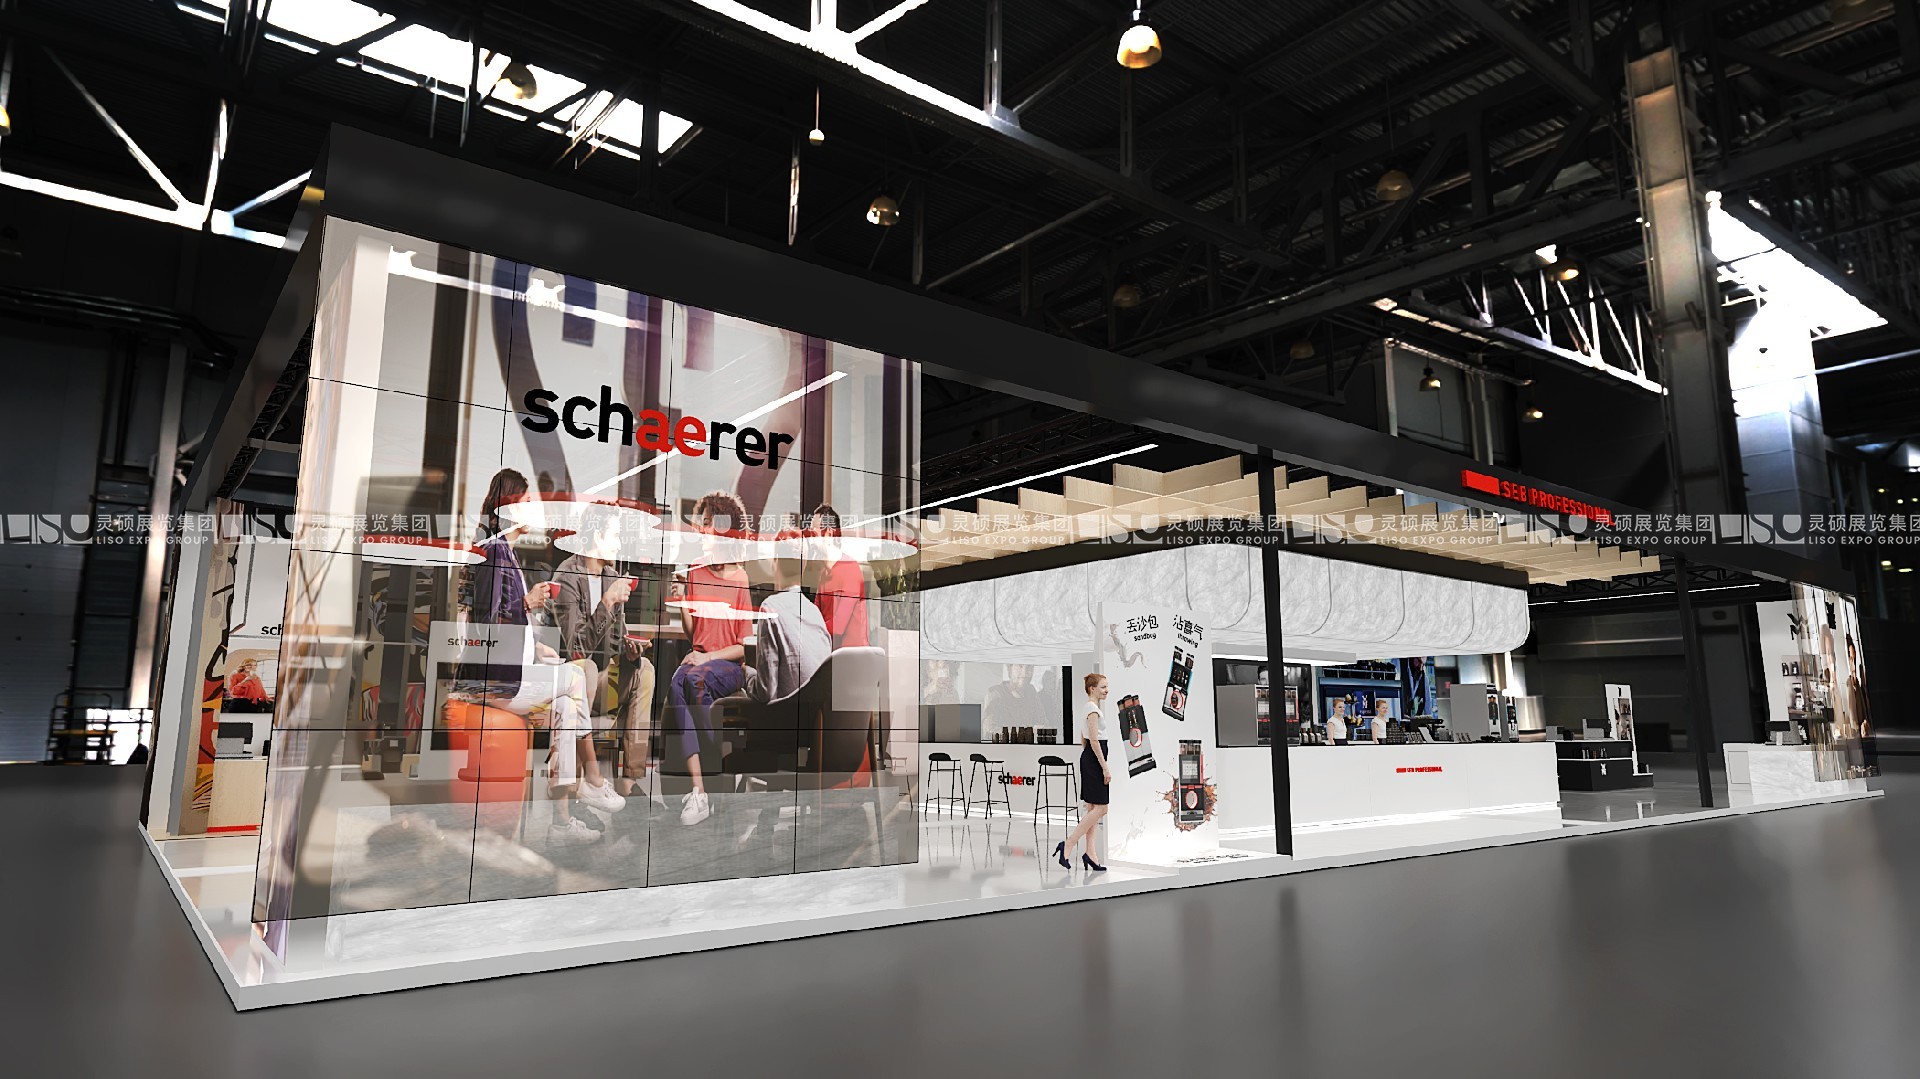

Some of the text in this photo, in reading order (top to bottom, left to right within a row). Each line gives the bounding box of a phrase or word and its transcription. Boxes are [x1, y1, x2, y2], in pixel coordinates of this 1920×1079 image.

[520, 384, 794, 470] schaerer
[1501, 481, 1526, 502] SEB
[1126, 614, 1159, 633] 丢沙包
[1173, 614, 1204, 641] 沾喜气
[447, 635, 499, 648] schaerer
[998, 771, 1036, 786] schaerer
